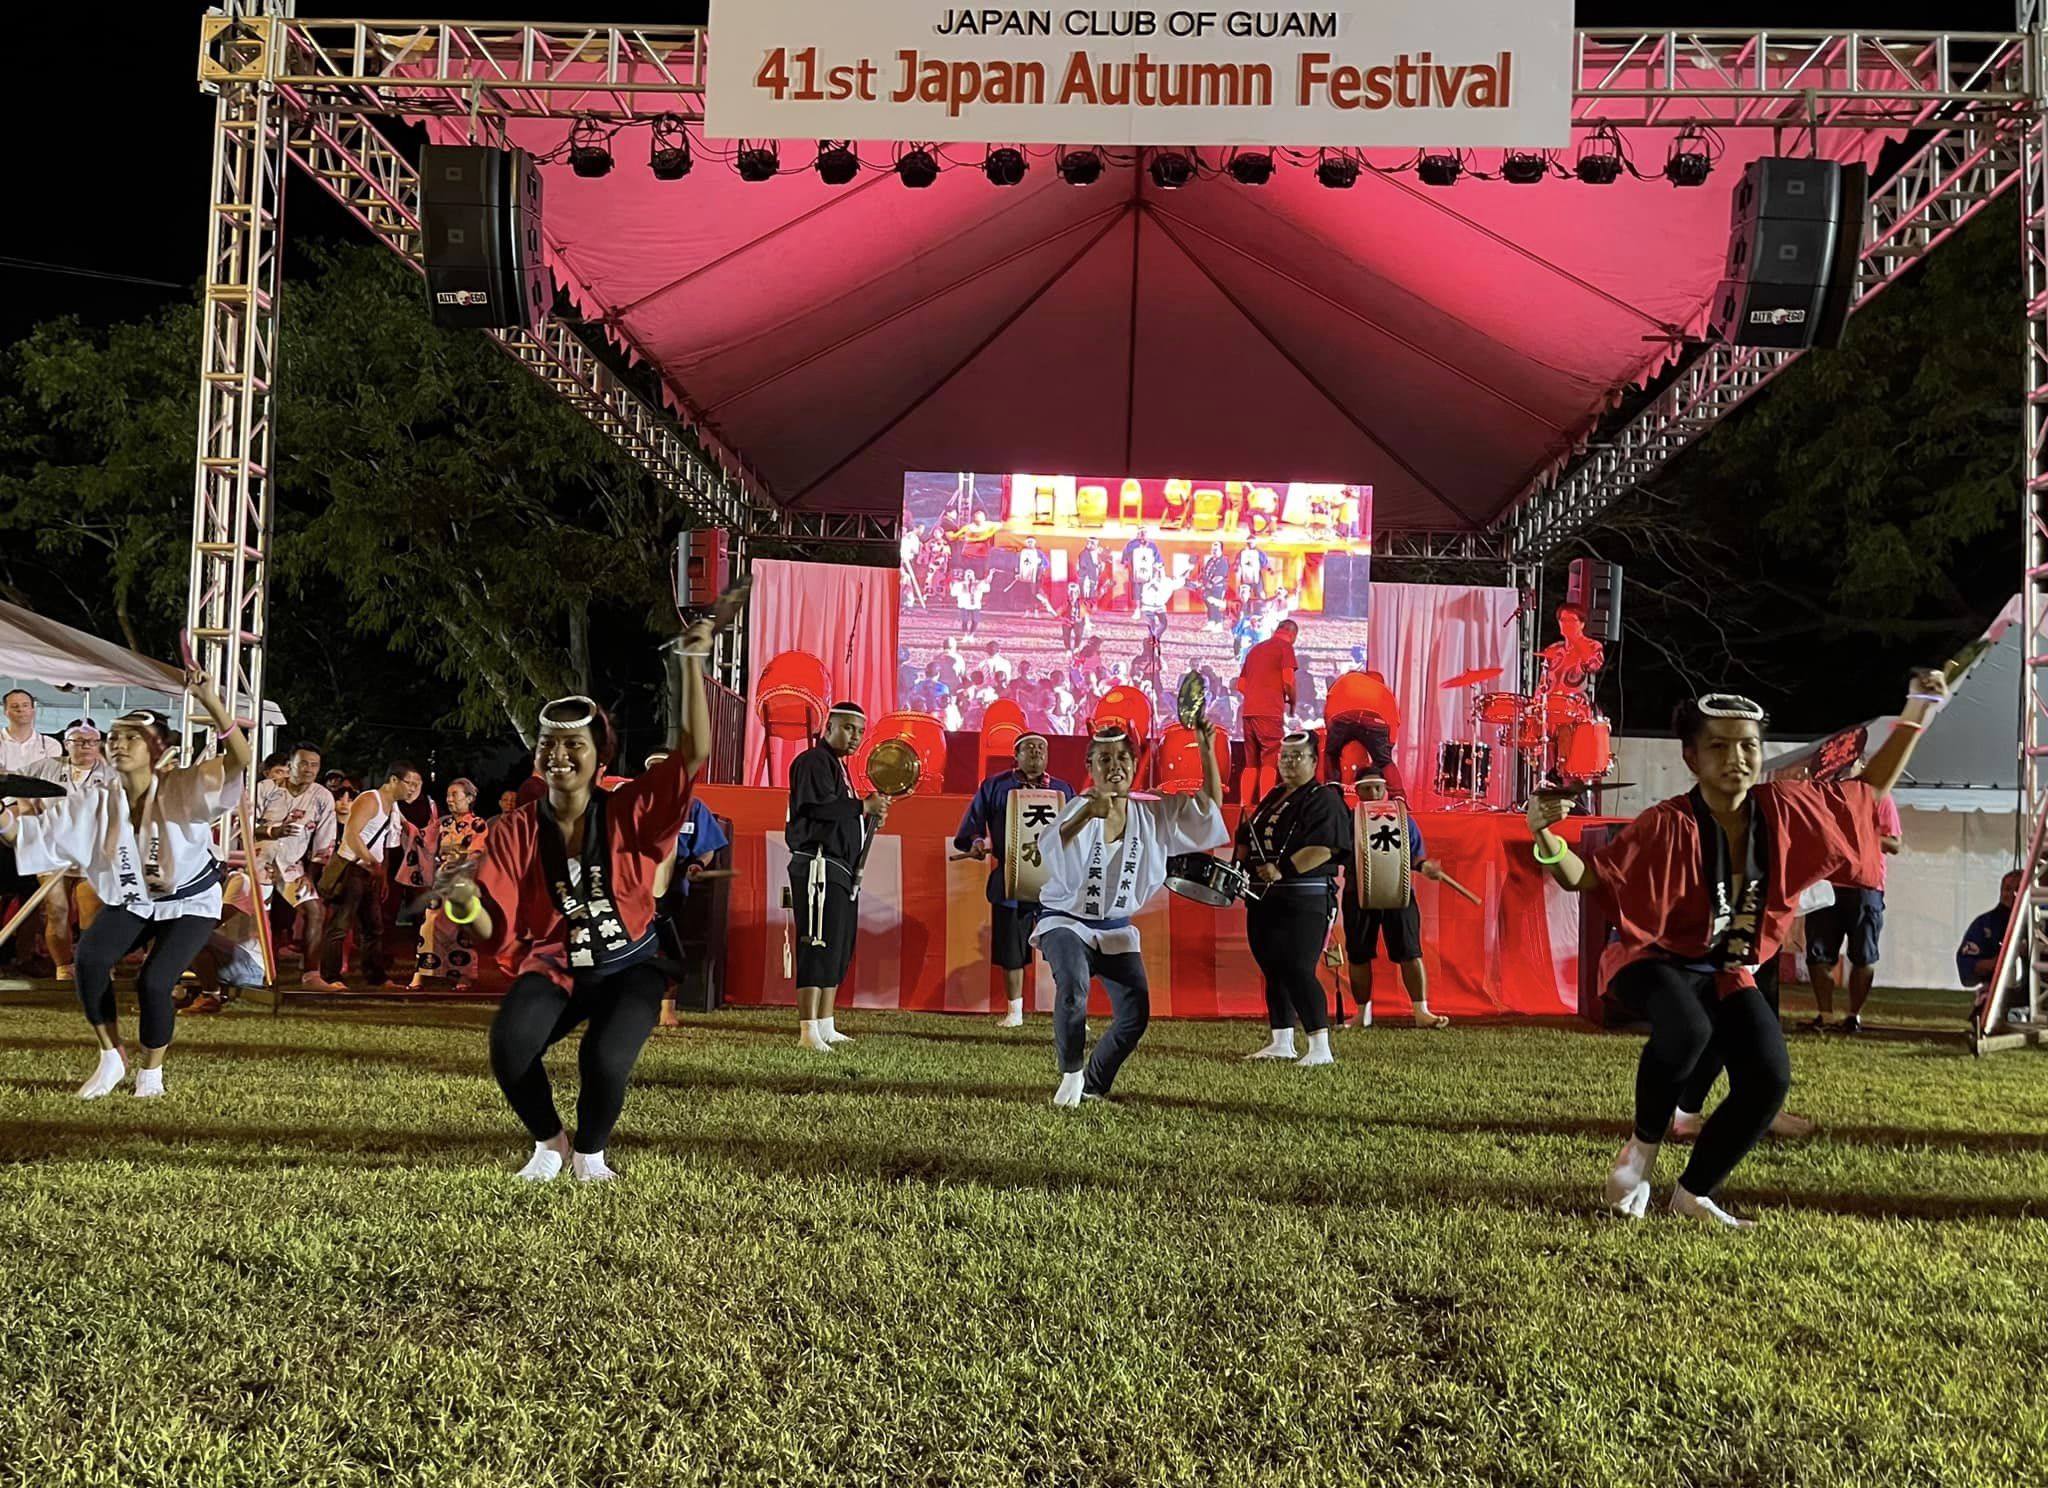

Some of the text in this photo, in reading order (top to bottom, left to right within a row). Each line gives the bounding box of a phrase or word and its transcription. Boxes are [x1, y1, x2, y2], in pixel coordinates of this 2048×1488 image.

[937, 9, 1337, 38] JAPAN CLUB OF GUAM
[757, 47, 1511, 117] 41st Japan Autumn Festival
